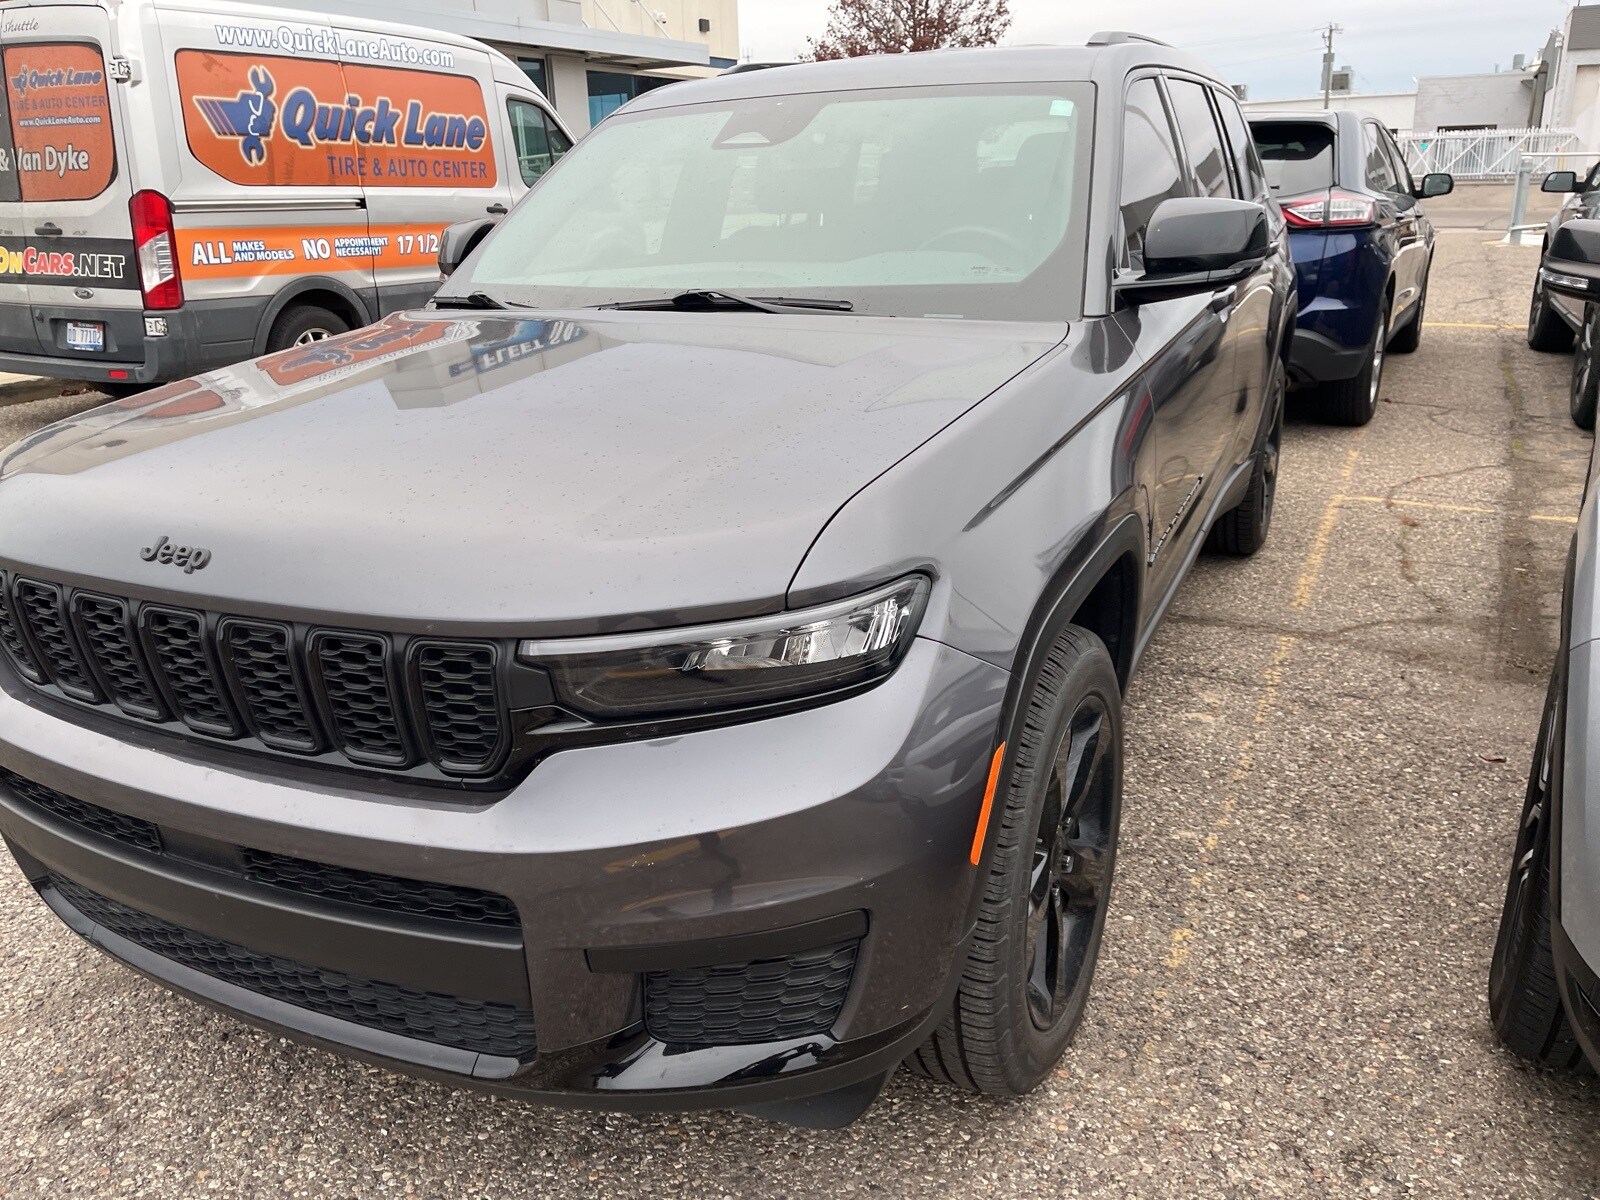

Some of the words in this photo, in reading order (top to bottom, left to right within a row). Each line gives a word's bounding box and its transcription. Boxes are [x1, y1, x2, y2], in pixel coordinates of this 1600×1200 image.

[214, 24, 455, 68] www.QuickLaneAuto.com
[28, 67, 65, 90] Quick
[65, 67, 102, 86] Lane
[40, 98, 62, 110] AUTO
[64, 95, 107, 108] CENTER
[19, 115, 102, 128] www.QuickLaneAuto.com
[281, 87, 402, 149] Quick
[402, 99, 487, 152] Lane
[11, 146, 42, 172] Van
[44, 143, 89, 178] Dyke
[327, 155, 367, 176] TIRE
[372, 159, 383, 177] &
[388, 159, 428, 178] AUTO
[432, 160, 488, 179] CENTER
[192, 241, 232, 266] ALL
[232, 240, 265, 252] MAKES
[301, 238, 331, 260] NO
[334, 237, 389, 248] APPOINTMENT
[335, 246, 383, 258] NECESSARY!
[396, 234, 414, 255] 17
[234, 251, 258, 262] AND
[257, 249, 295, 261] MODELS
[140, 535, 212, 575] Jeep
